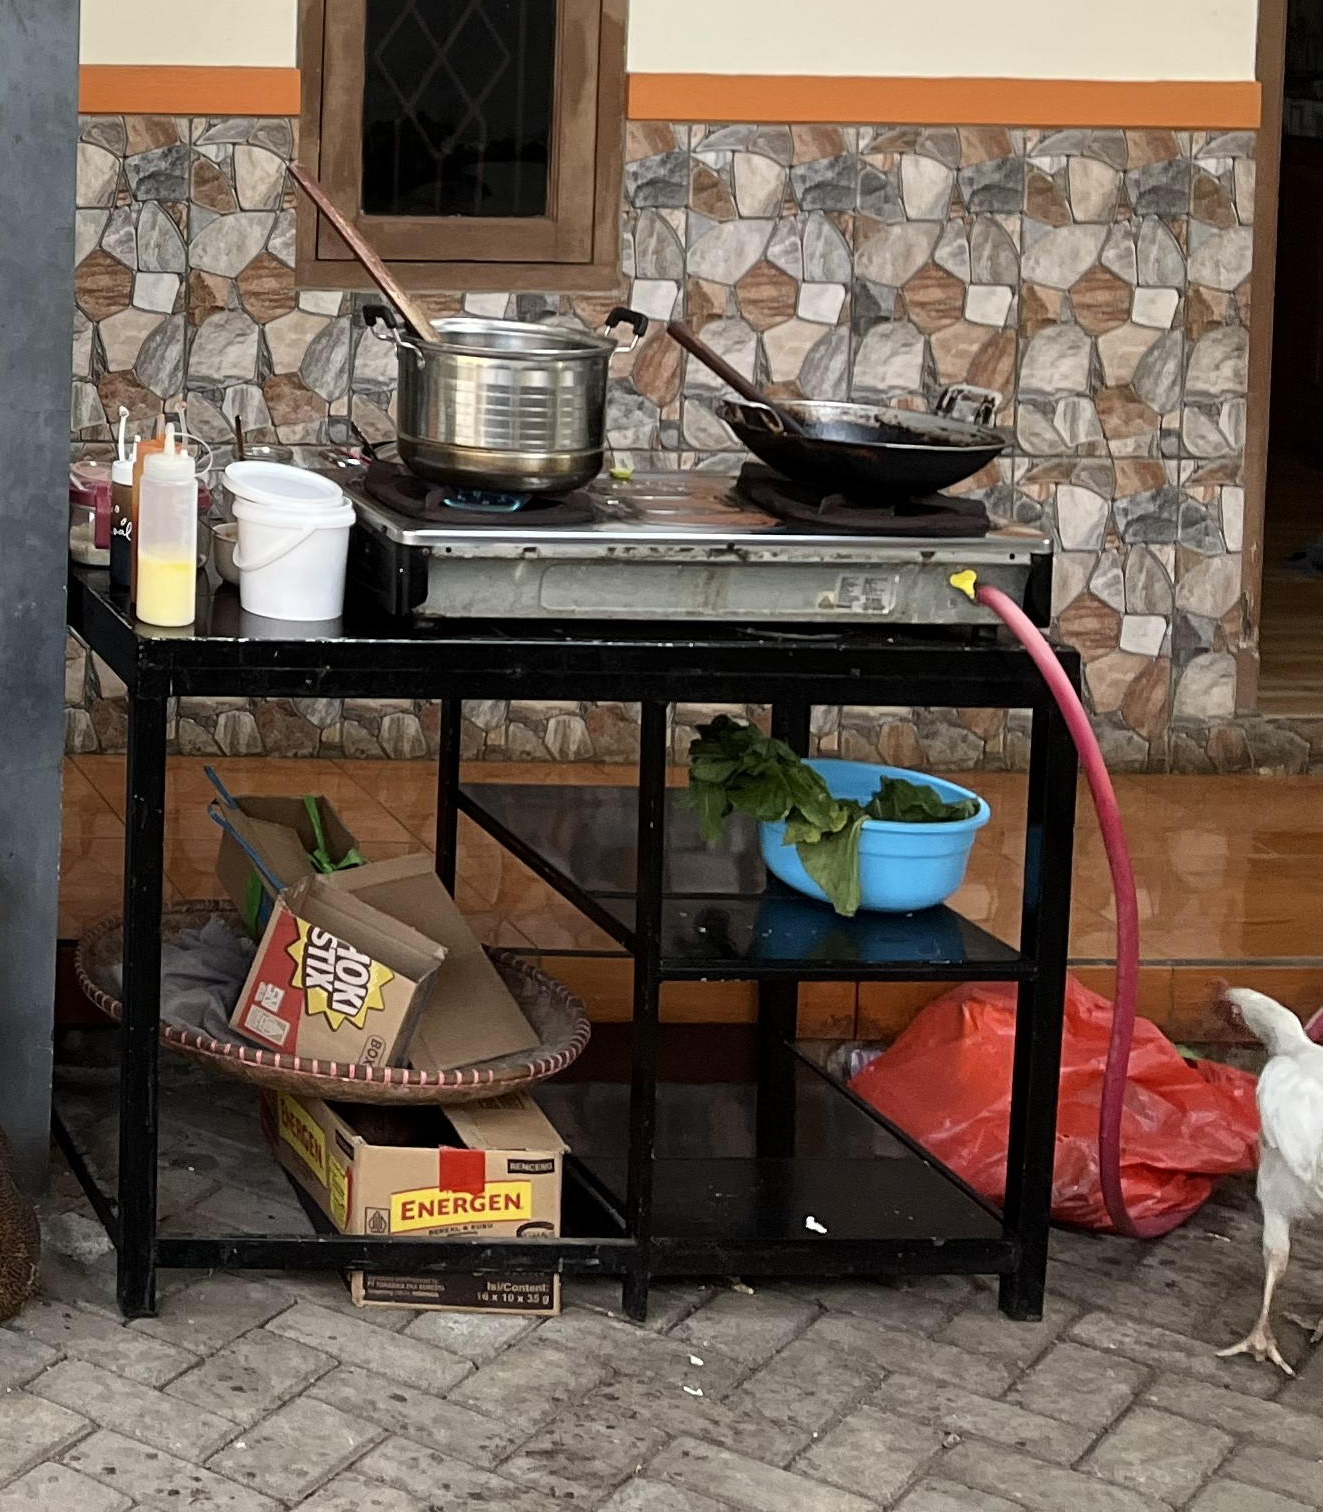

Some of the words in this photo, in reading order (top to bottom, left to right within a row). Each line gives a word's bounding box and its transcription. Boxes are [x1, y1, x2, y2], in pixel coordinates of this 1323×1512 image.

[306, 926, 338, 992] STIX
[400, 1192, 521, 1222] ENERGEN
[487, 1281, 550, 1293] Isi/Content:
[502, 1294, 514, 1303] 10
